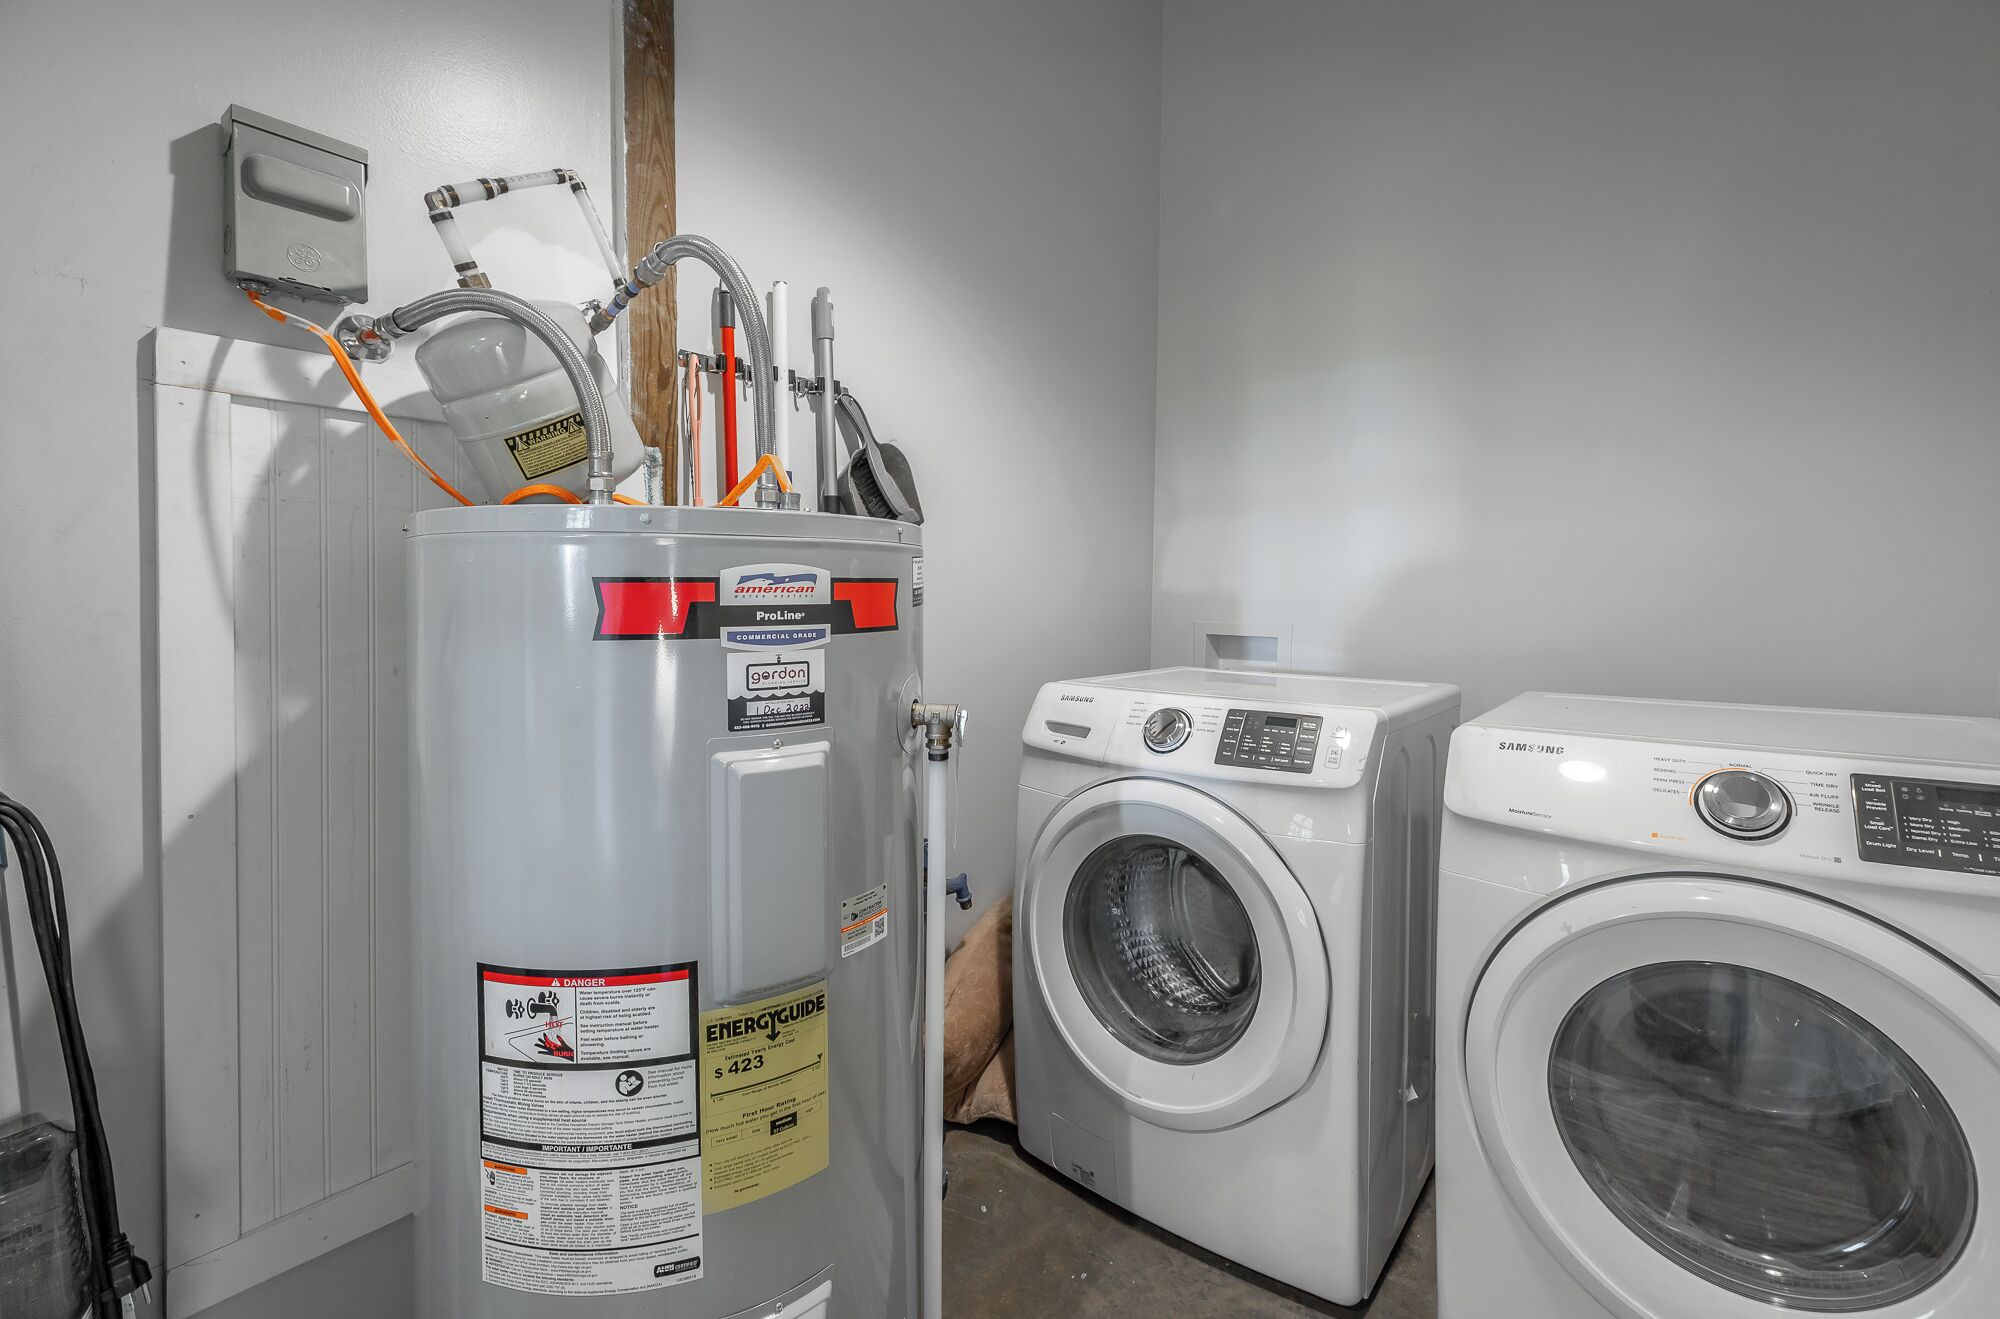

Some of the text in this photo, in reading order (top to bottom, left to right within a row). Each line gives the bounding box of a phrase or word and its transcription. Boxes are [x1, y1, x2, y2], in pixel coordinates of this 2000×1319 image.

[527, 427, 566, 445] WARNING
[752, 667, 805, 684] gordon
[764, 705, 781, 714] Dec
[1499, 742, 1564, 754] SAMSUNG
[706, 994, 825, 1042] ENERGYGUIDE
[725, 1051, 750, 1060] Estimated
[752, 1047, 767, 1055] Yearly
[768, 1042, 784, 1050] Energy
[715, 1055, 764, 1079] $ 423
[760, 1105, 774, 1113] Hour
[776, 1097, 796, 1107] Rating
[586, 1143, 632, 1152] IMPORTANTE
